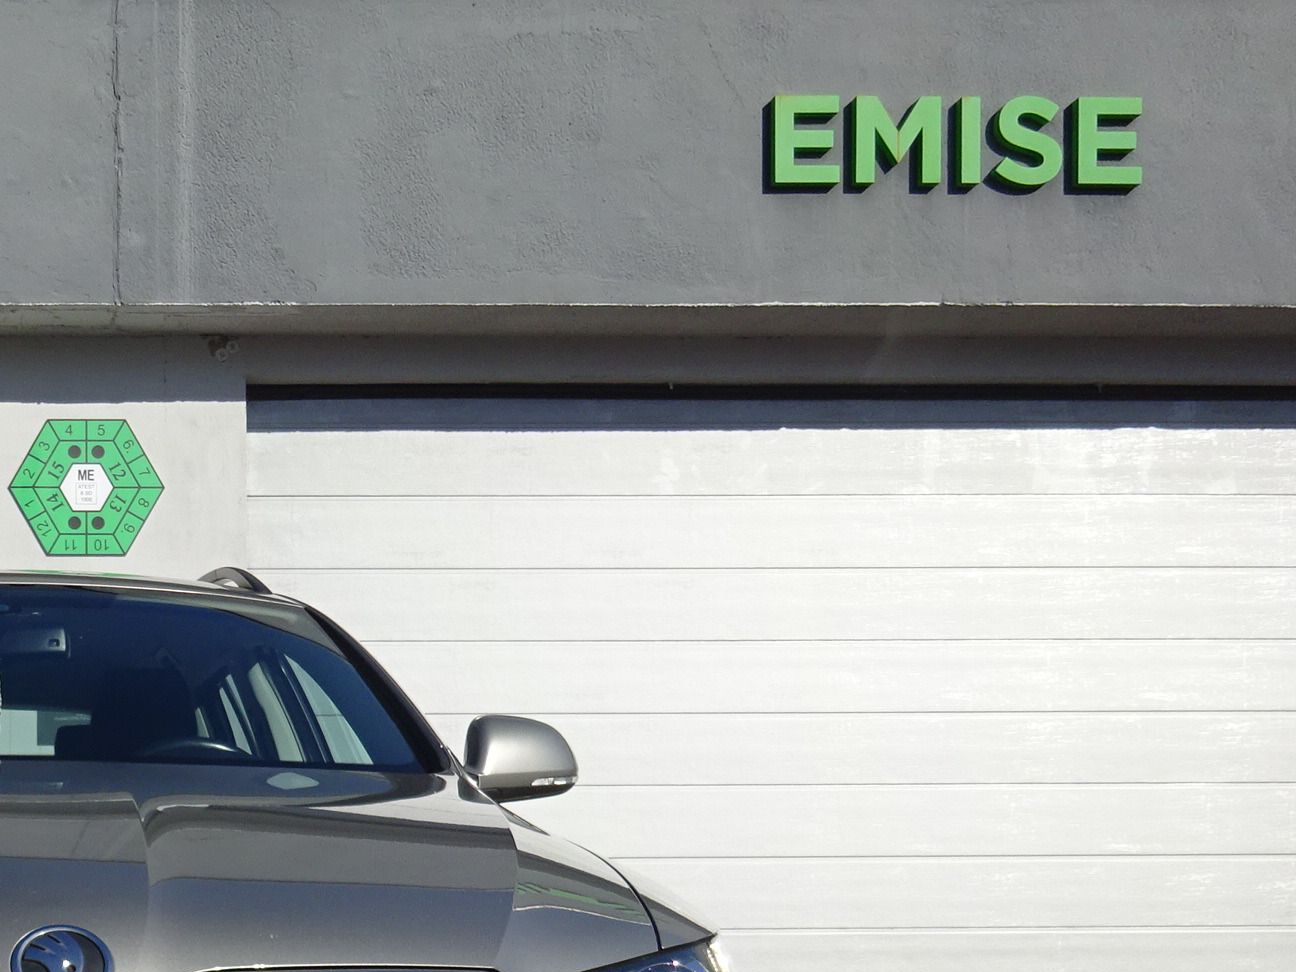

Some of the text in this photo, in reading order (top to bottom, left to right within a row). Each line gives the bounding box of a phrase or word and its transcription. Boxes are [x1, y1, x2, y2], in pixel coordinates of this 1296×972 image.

[770, 95, 1143, 188] EMISE
[65, 424, 73, 436] 4
[97, 424, 106, 436] 5
[38, 440, 51, 451] 3
[22, 467, 36, 480] 2
[48, 461, 65, 481] 15
[77, 469, 95, 481] ME
[108, 461, 127, 481] 12
[138, 467, 151, 476] 7
[46, 493, 65, 512] 14
[109, 494, 128, 513] 13
[137, 497, 150, 509] 8
[36, 519, 53, 537] 12
[64, 539, 78, 550] 11
[94, 539, 110, 551] 10
